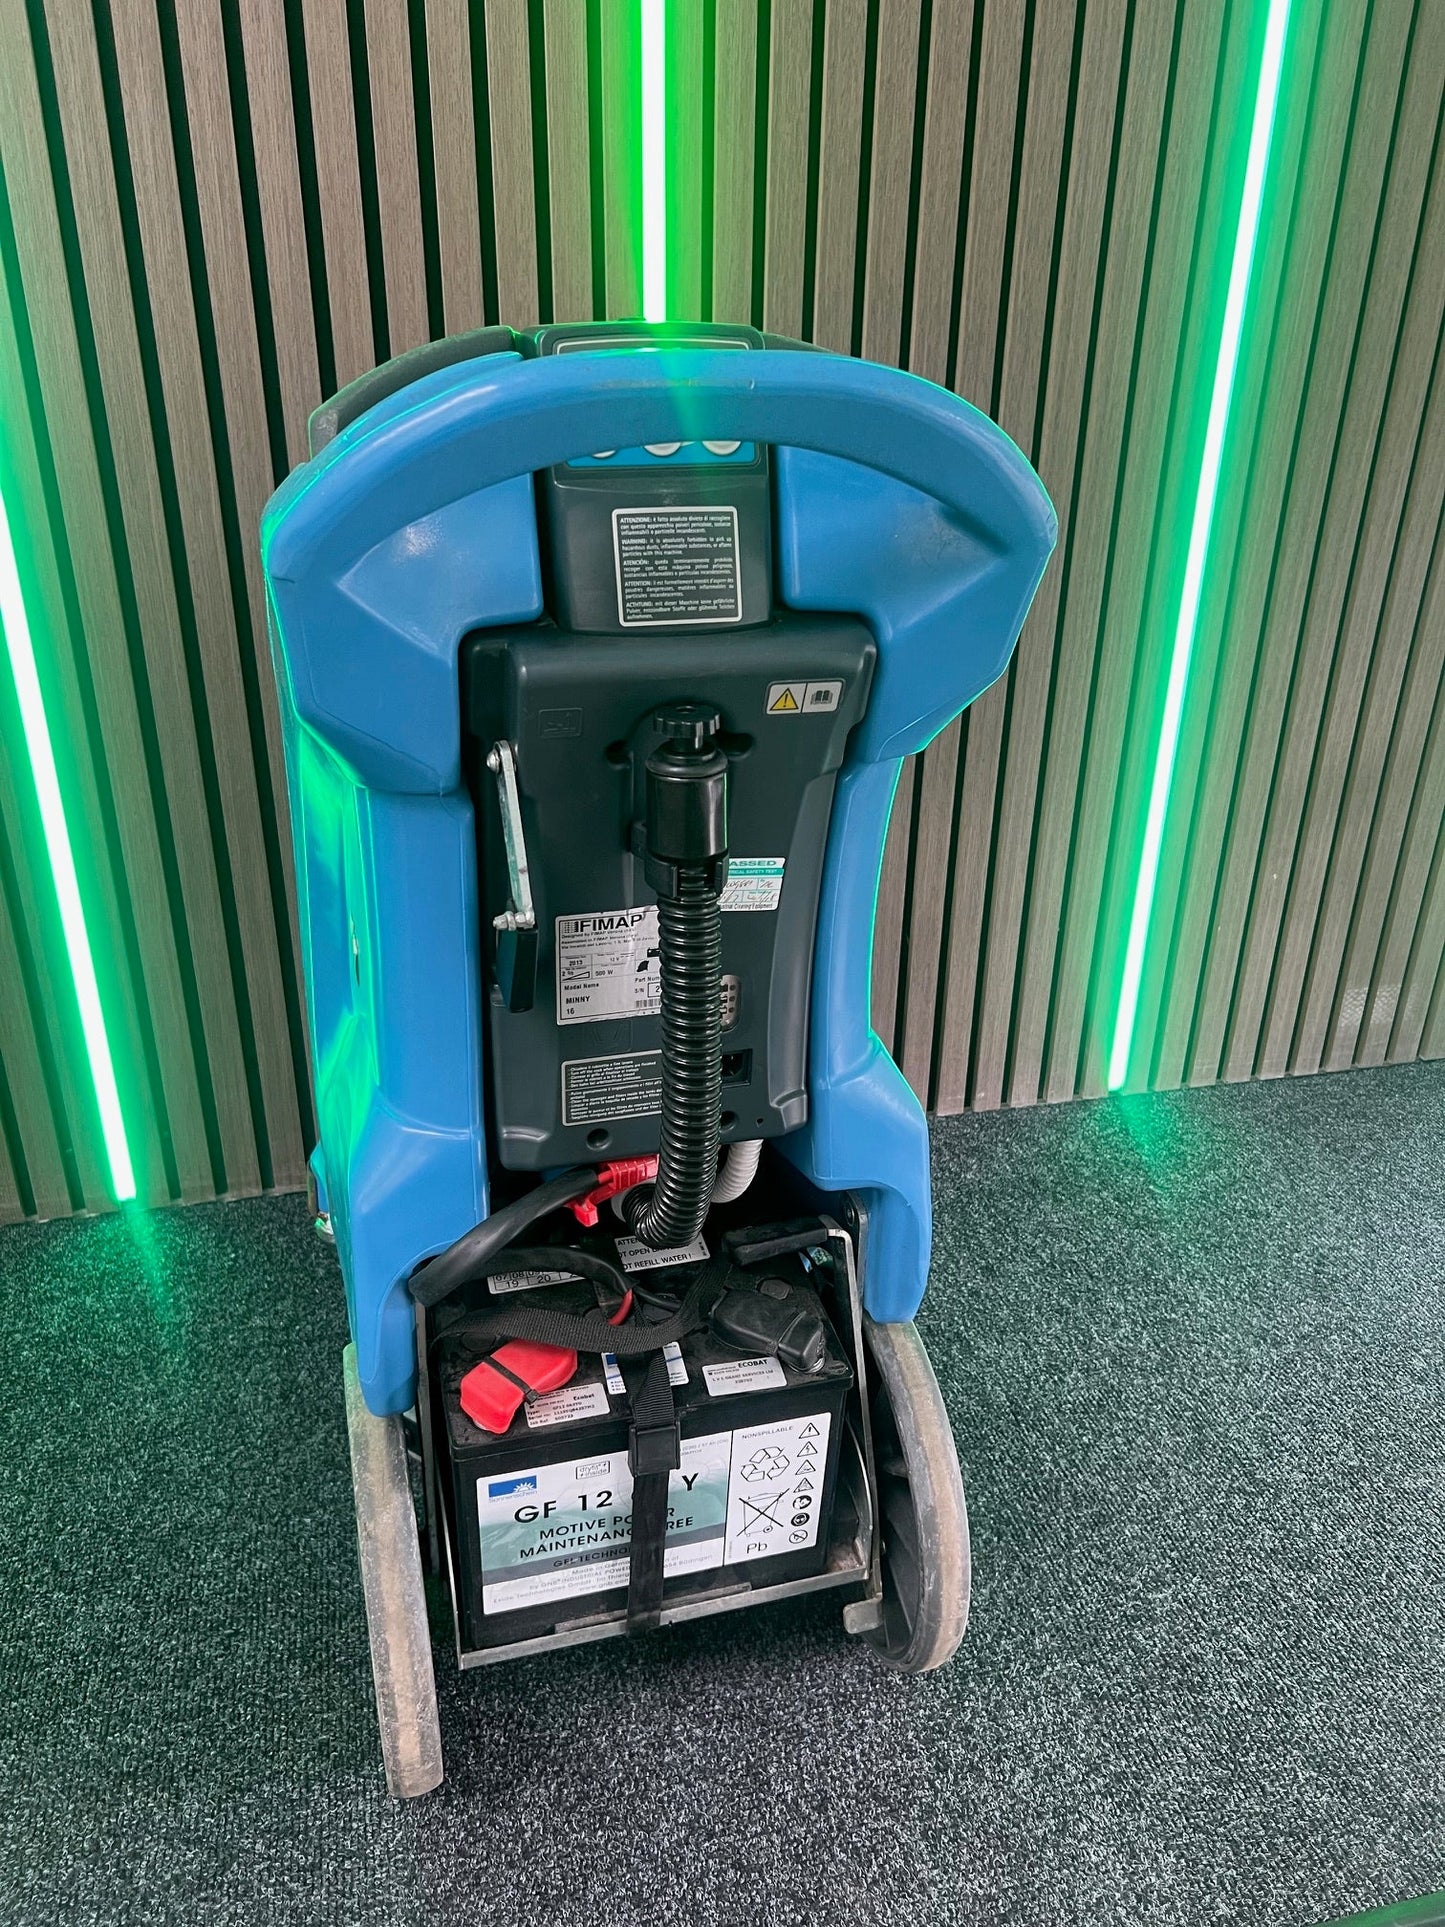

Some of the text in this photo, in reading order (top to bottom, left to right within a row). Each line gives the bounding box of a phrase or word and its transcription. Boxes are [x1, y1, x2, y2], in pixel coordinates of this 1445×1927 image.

[580, 914, 643, 932] FIMAP
[564, 983, 582, 991] Model
[566, 996, 590, 1004] MINNY
[628, 1248, 650, 1257] OPEN
[634, 1259, 661, 1268] REFILL
[660, 1253, 688, 1264] WATER
[506, 1280, 519, 1288] 19
[537, 1274, 551, 1284] 20
[738, 1359, 768, 1368] ECOBAT
[741, 1425, 794, 1440] NONSPILLABLE
[514, 1472, 699, 1524] GF 12 Y
[539, 1517, 606, 1540] MOTIVE
[519, 1516, 693, 1559] MAINTENANC REE
[746, 1541, 768, 1554] Pb
[553, 1547, 631, 1568] GEL-TECHNO
[604, 1560, 630, 1570] Germa
[607, 1572, 630, 1581] Thierg
